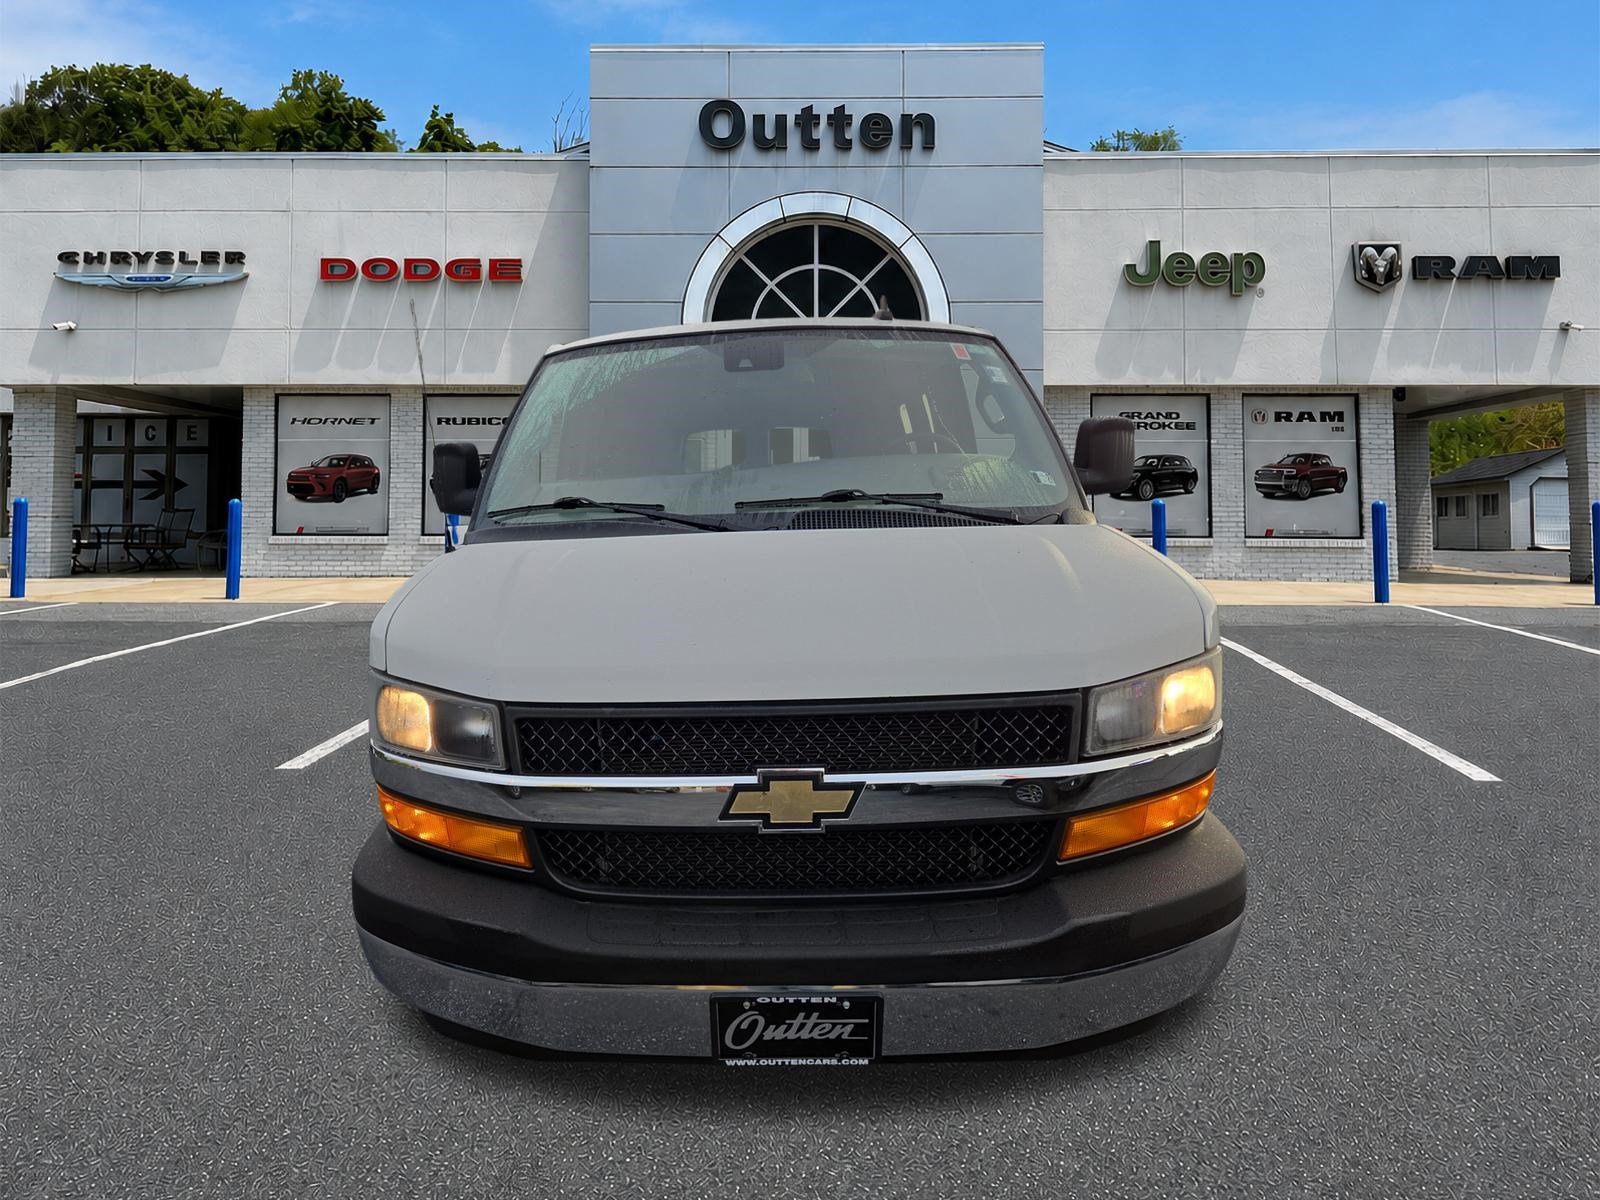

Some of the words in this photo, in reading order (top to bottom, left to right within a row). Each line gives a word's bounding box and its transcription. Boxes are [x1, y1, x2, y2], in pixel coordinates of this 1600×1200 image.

[698, 99, 936, 150] Outten
[57, 250, 247, 266] CHRYSLER
[320, 258, 523, 282] DODGE
[1123, 240, 1267, 297] Jeep
[1411, 255, 1561, 280] RAM
[290, 416, 382, 427] HORNET
[436, 416, 511, 426] RUBIC
[1118, 411, 1181, 421] GRAND
[1273, 410, 1345, 423] RAM
[1133, 421, 1197, 431] ROKEE
[756, 996, 838, 1004] OUTTEN
[724, 1010, 870, 1051] Outten
[725, 1057, 869, 1067] WWW.OUTTENCARS.COM
